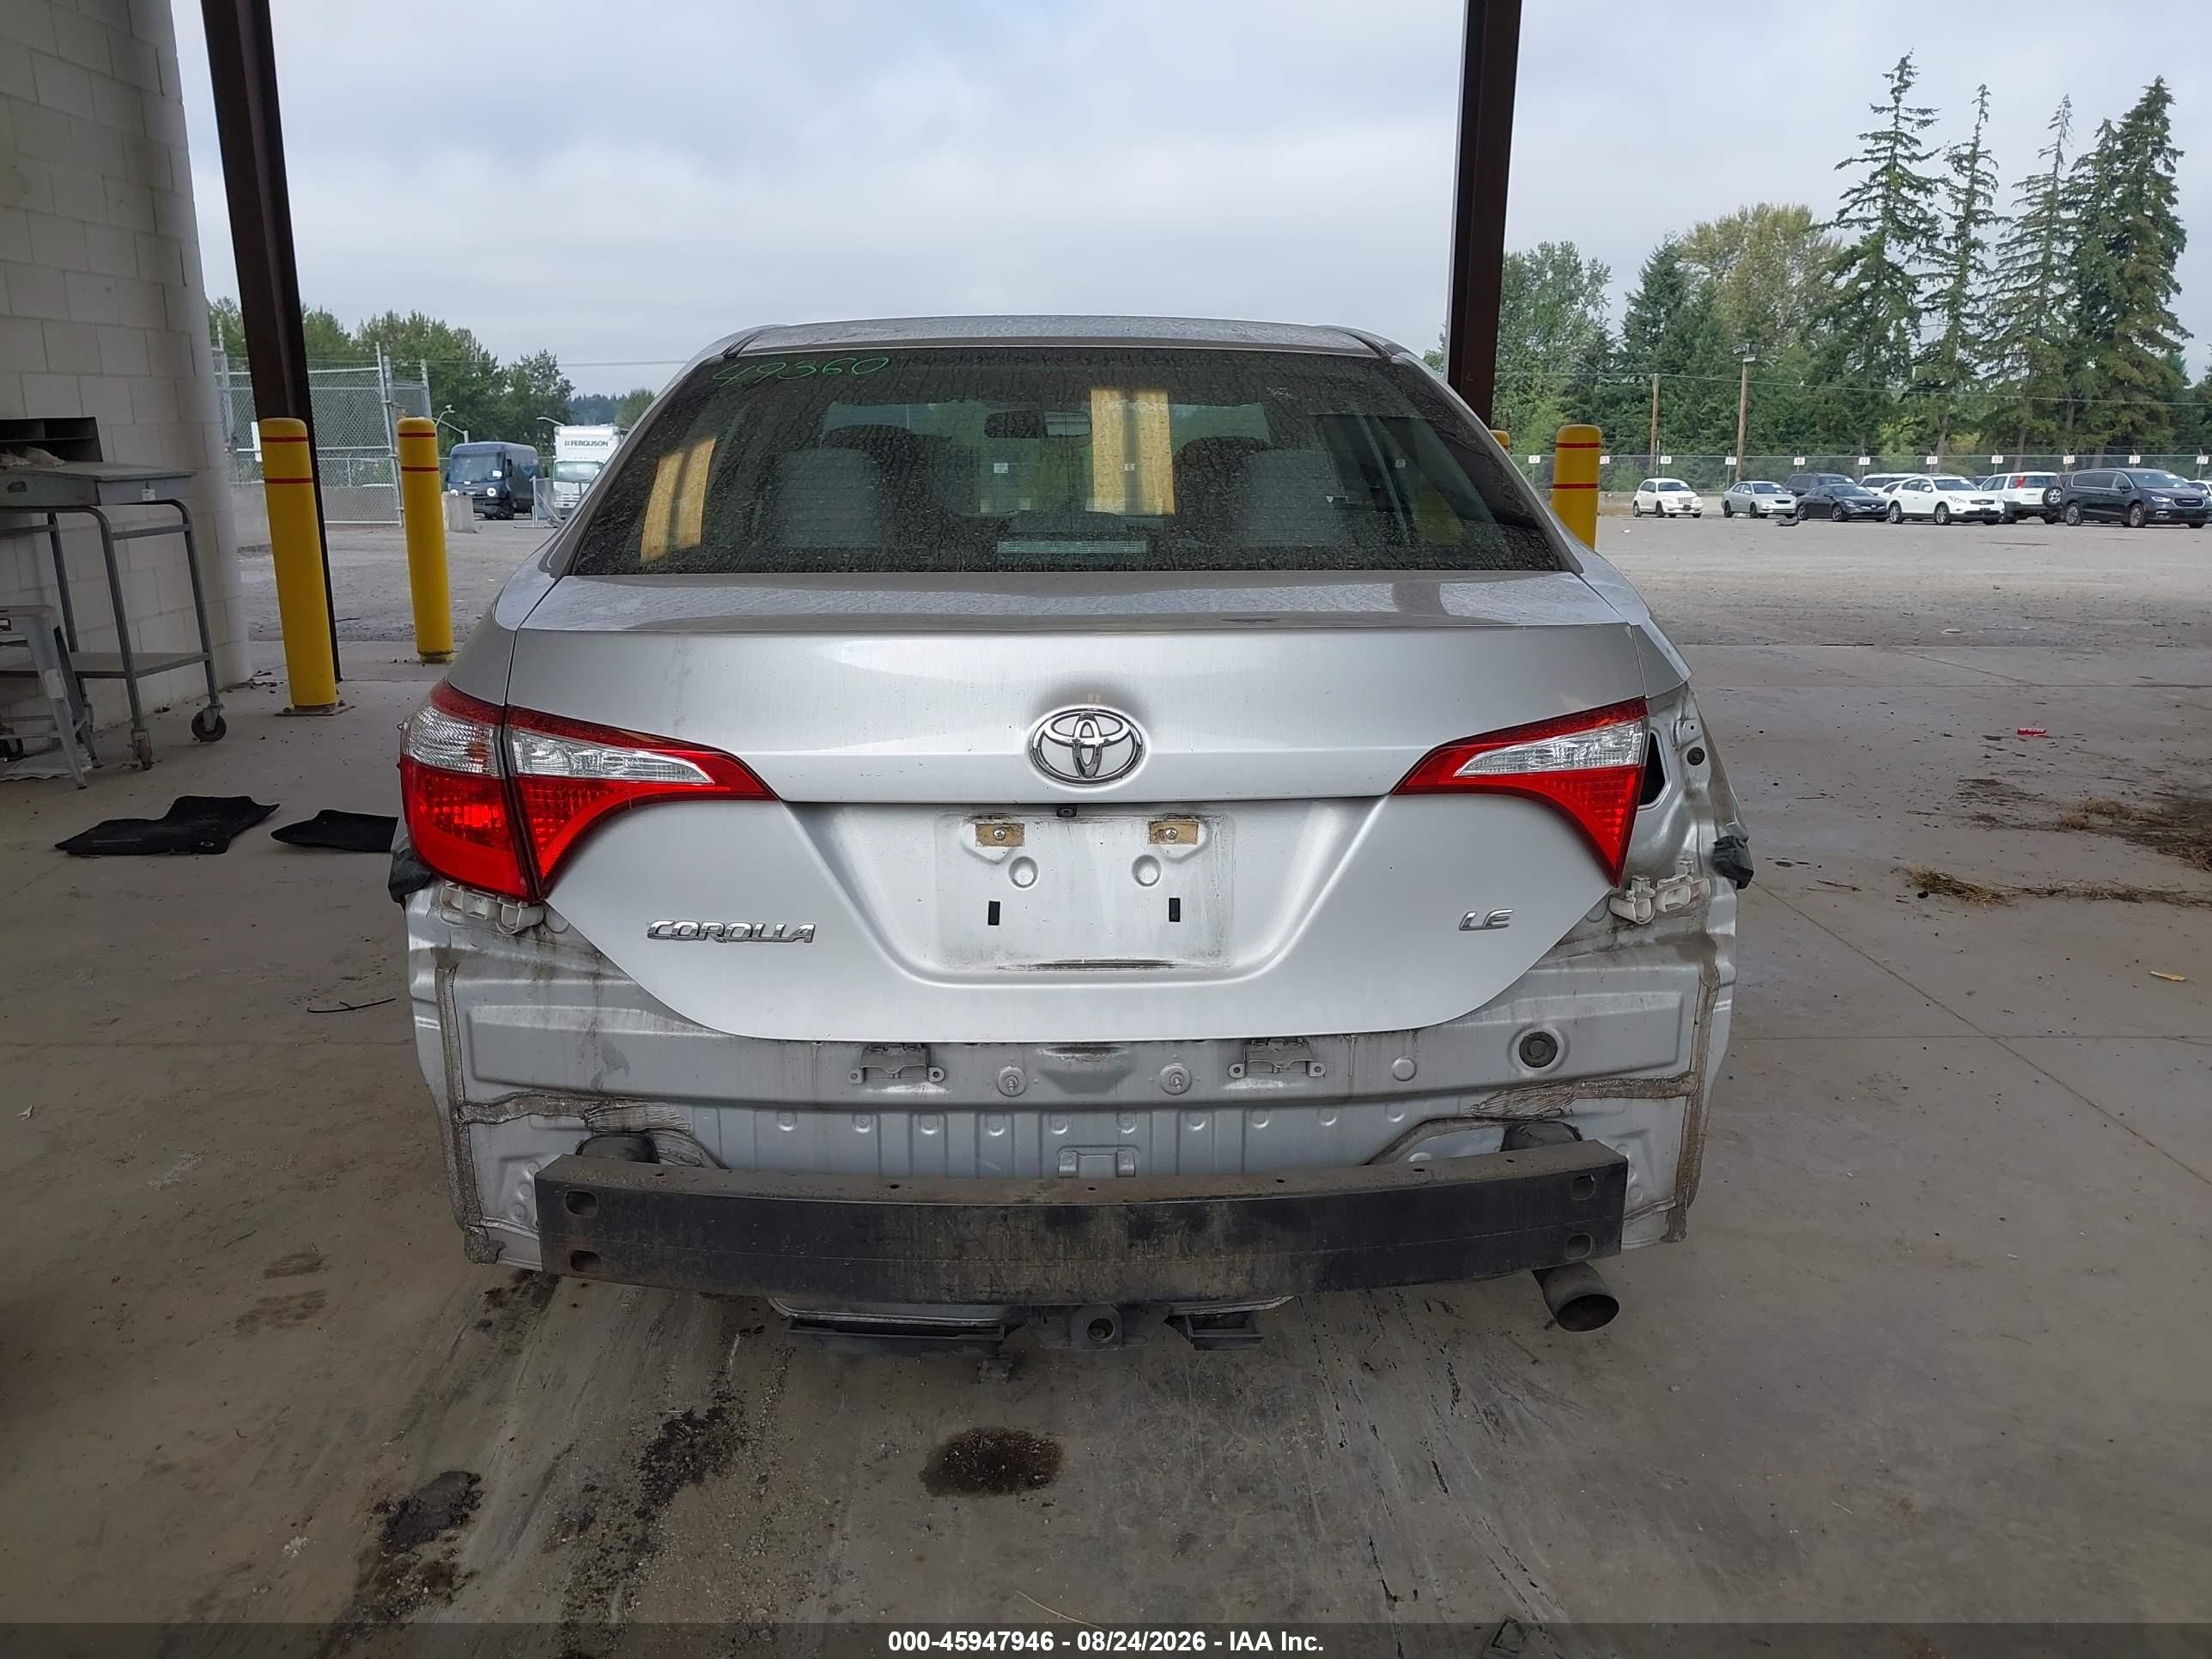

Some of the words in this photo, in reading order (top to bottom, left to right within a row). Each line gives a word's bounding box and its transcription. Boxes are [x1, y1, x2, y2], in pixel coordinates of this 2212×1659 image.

[713, 357, 889, 386] 49360
[1459, 908, 1514, 931] LE
[647, 920, 817, 943] COROLLA
